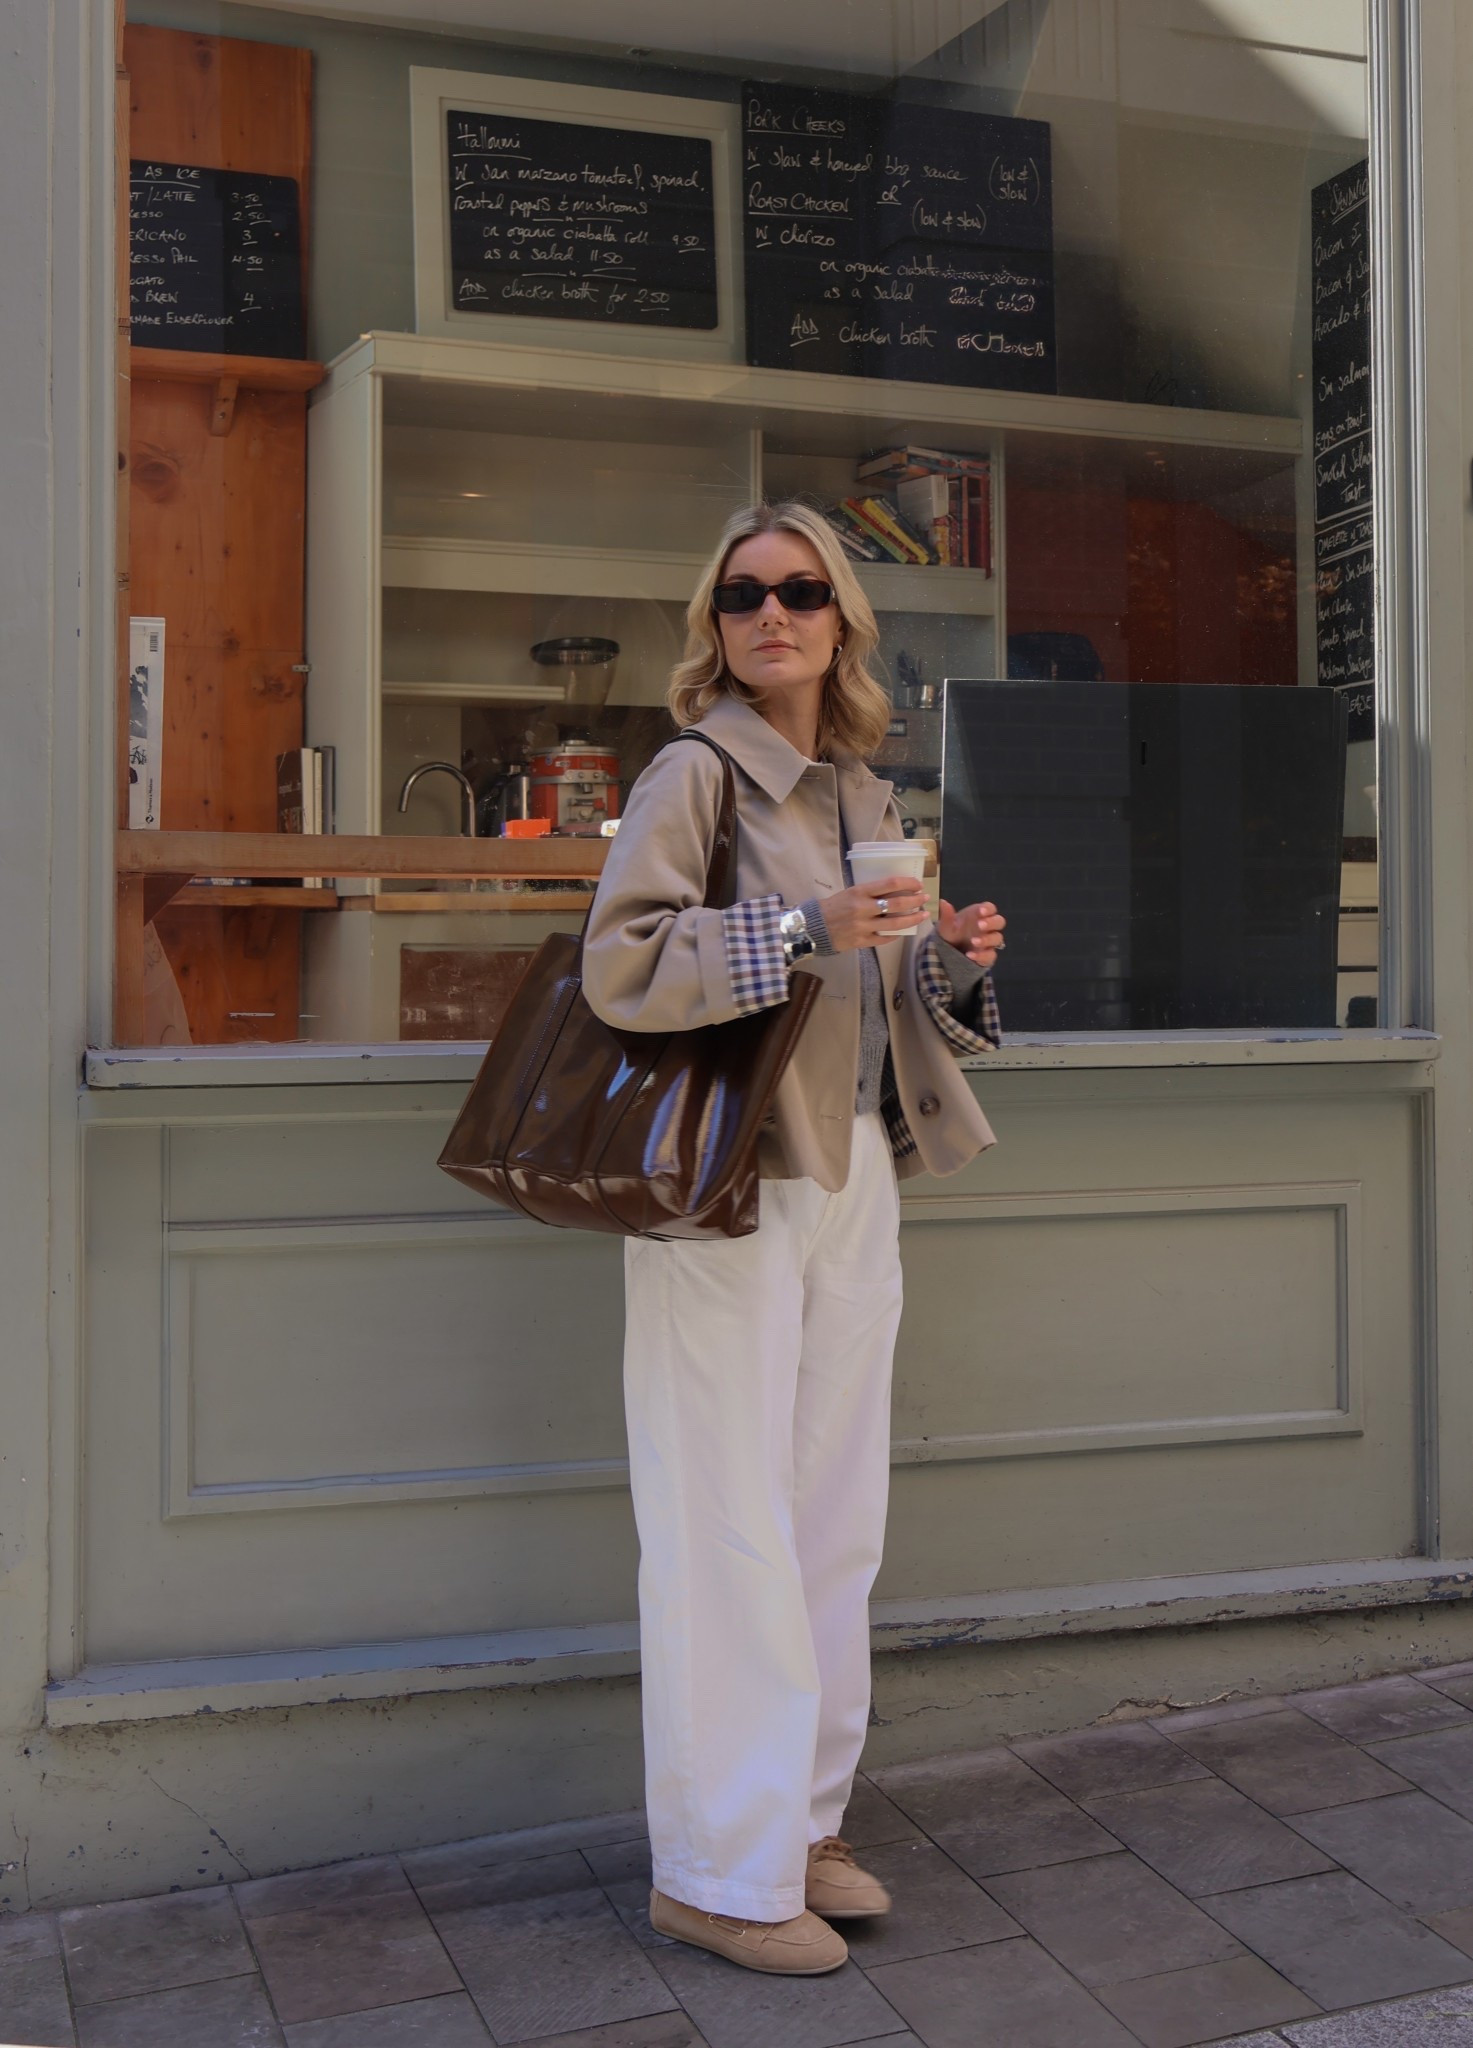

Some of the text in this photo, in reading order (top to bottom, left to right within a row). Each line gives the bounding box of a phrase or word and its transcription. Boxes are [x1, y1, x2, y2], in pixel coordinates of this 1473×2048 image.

[747, 99, 847, 133] PORK CHEEKS
[457, 123, 521, 150] Halloumi
[144, 165, 163, 180] AS
[176, 167, 200, 180] ICE
[518, 167, 577, 182] marzano
[768, 145, 801, 171] slaw
[827, 147, 873, 182] honeyed
[922, 165, 968, 181] sauce
[454, 192, 504, 211] roasted
[510, 197, 551, 218] peppers
[573, 195, 648, 214] mushrooms
[748, 181, 788, 213] ROAST
[790, 192, 849, 214] CHICKEN
[243, 229, 252, 240] 3
[483, 226, 500, 238] on
[507, 227, 556, 245] organic
[563, 224, 617, 243] ciabatta
[780, 223, 836, 247] chorizo
[484, 249, 501, 260] as
[509, 249, 520, 260] a
[1313, 236, 1345, 267] Bacon
[820, 261, 840, 273] on
[845, 263, 892, 282] organic
[243, 292, 254, 305] 4
[502, 278, 553, 299] chicken
[562, 281, 599, 303] broth
[606, 283, 627, 314] for
[823, 280, 913, 301] as a salad
[1314, 278, 1343, 305] Bacon
[840, 321, 892, 344] chicken
[900, 321, 937, 348] broth
[1313, 304, 1351, 342] Avocado
[1314, 426, 1335, 451] Eggs
